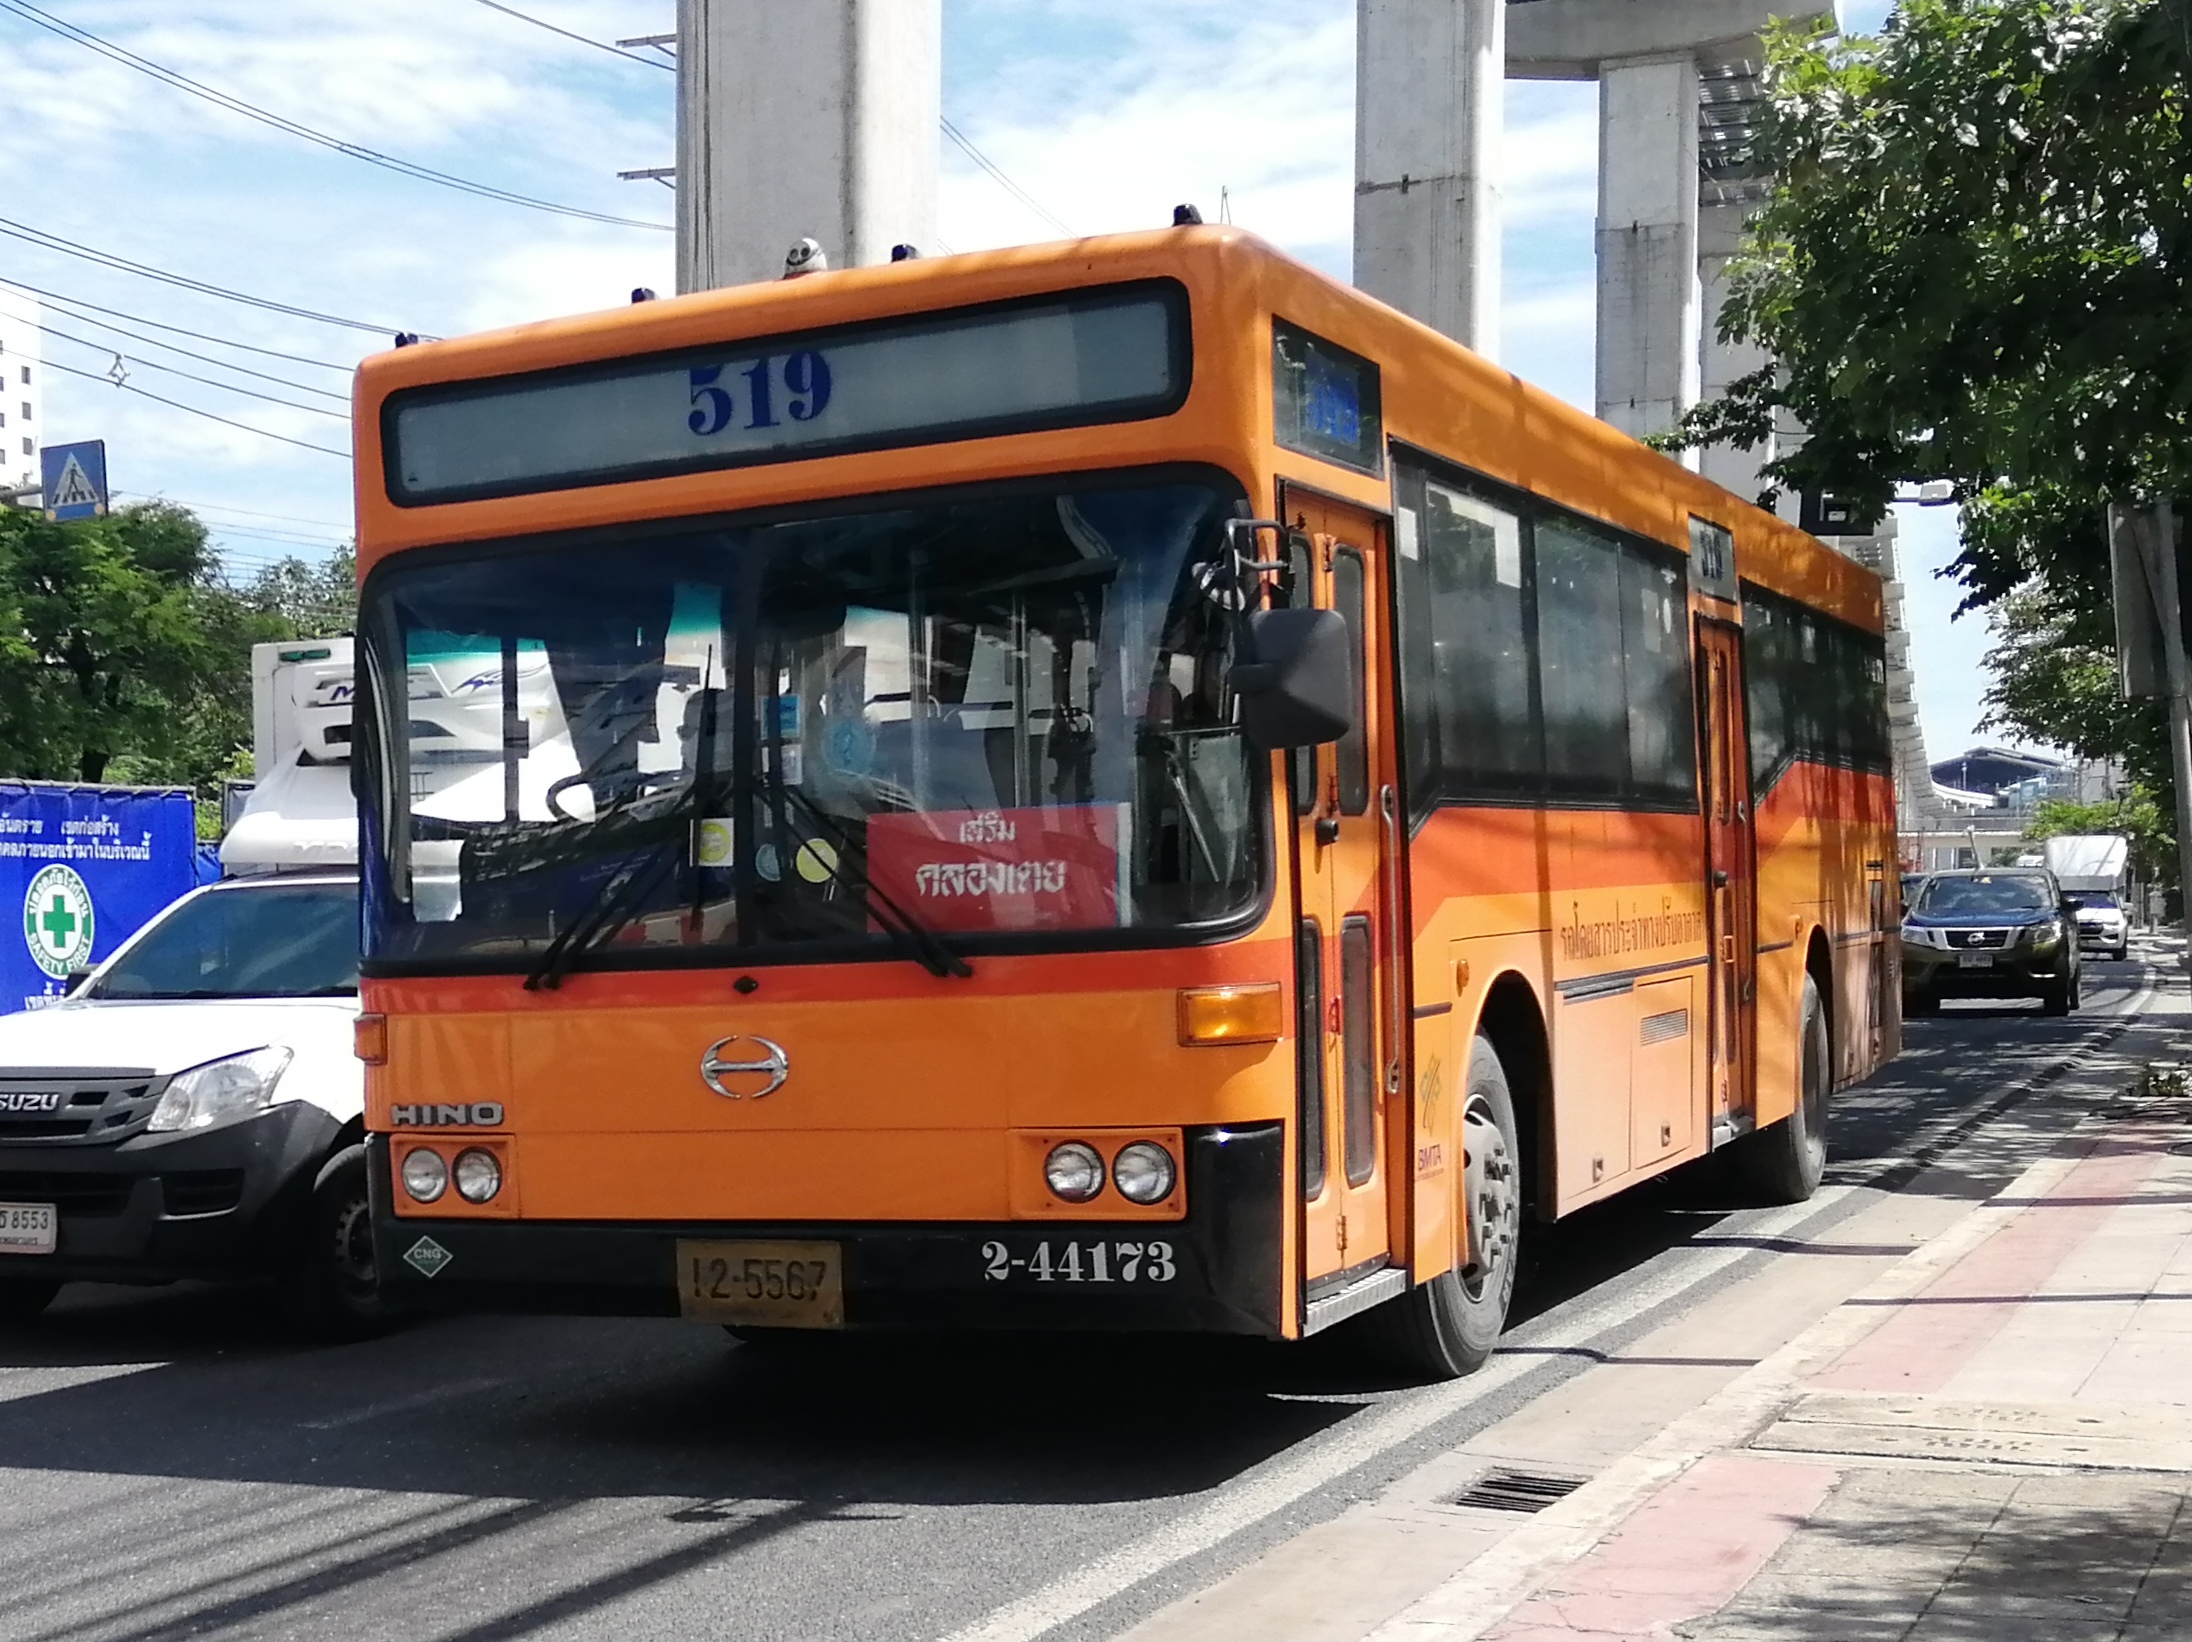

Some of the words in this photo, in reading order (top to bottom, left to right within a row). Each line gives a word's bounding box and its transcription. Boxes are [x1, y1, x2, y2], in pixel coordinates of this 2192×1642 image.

[688, 350, 832, 435] 519
[960, 811, 1015, 843] เสริม
[916, 861, 1067, 897] คลองเตย
[29, 933, 64, 974] SAFETY
[66, 935, 90, 972] FIRST
[390, 1102, 503, 1125] HINO
[1418, 1143, 1442, 1172] BMTA
[11, 1210, 48, 1230] 8553
[413, 1247, 441, 1260] CNG
[981, 1241, 1176, 1282] 2-44173
[693, 1257, 827, 1301] 12-5567
